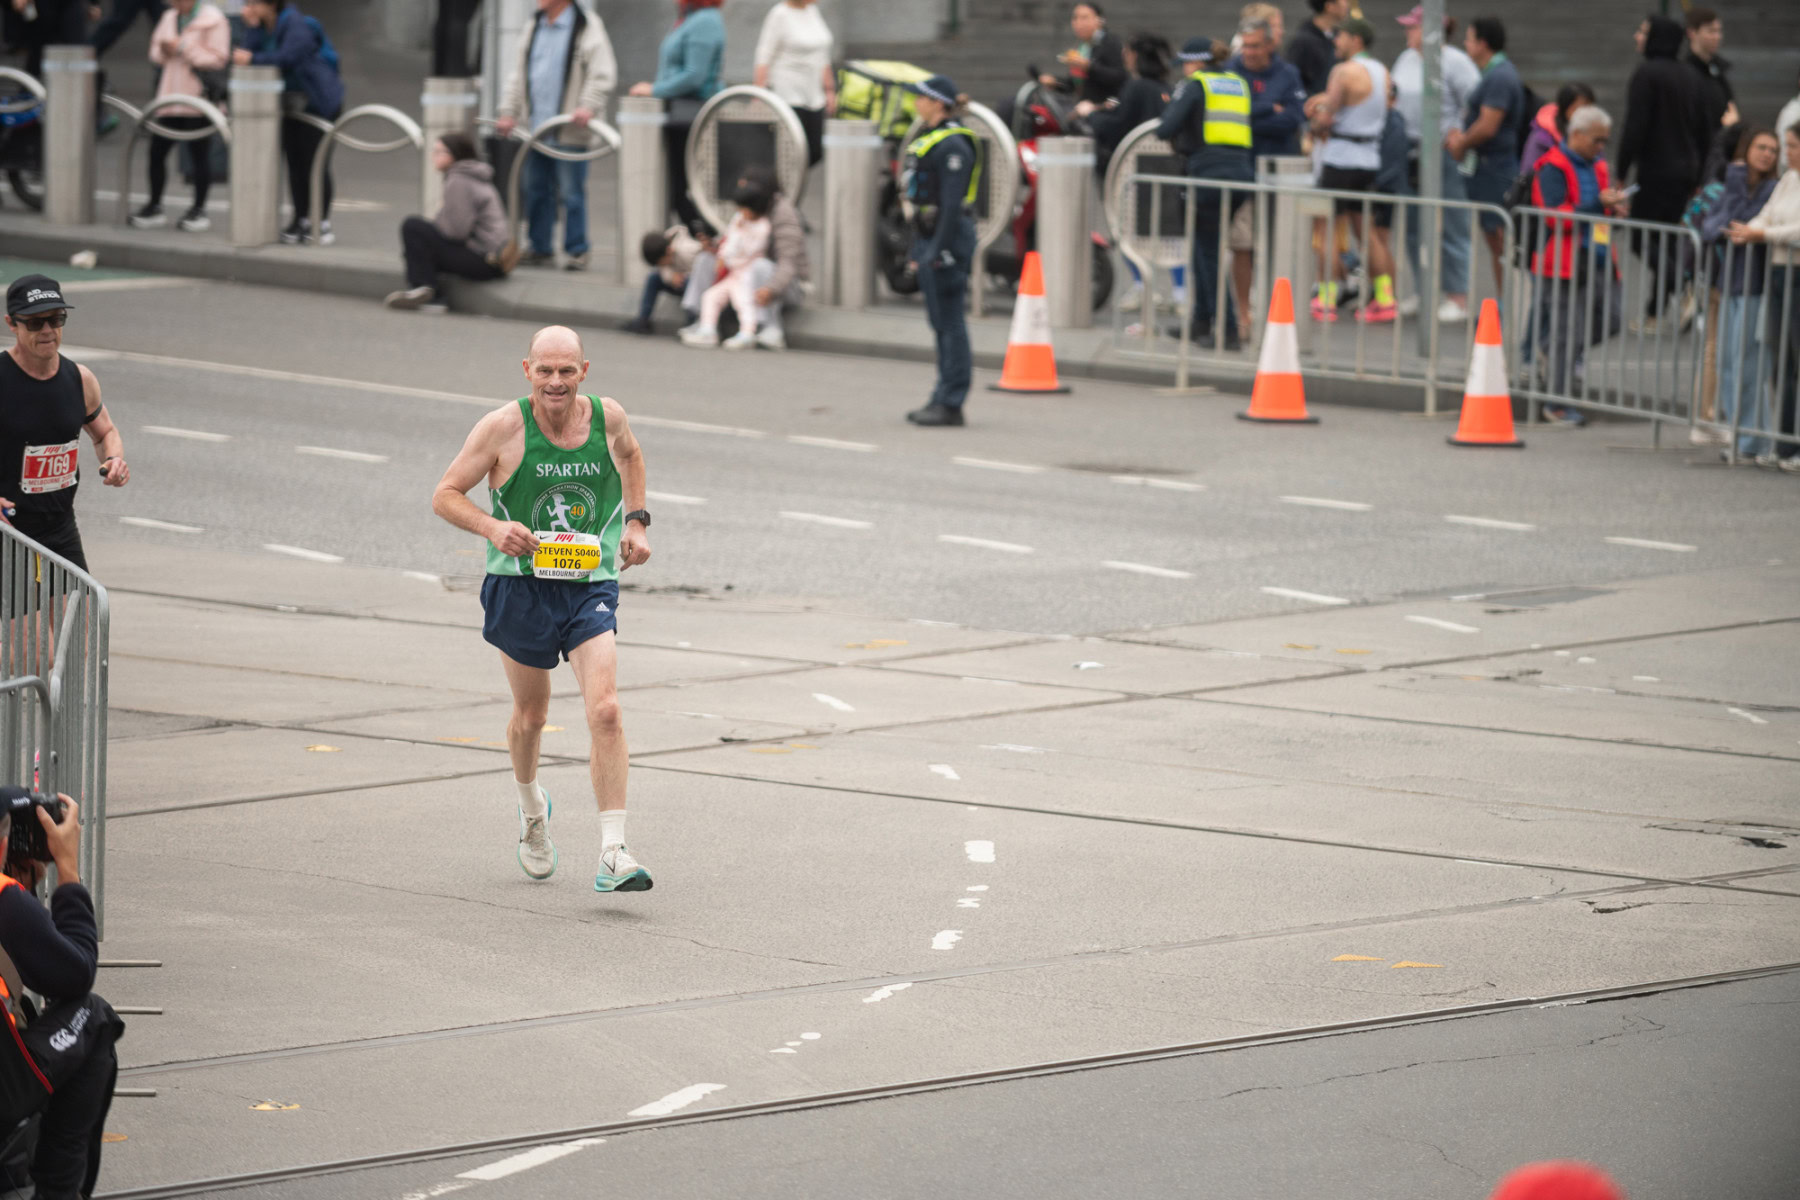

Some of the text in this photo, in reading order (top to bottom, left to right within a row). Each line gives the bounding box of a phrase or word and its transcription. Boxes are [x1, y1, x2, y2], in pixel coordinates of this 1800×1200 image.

[27, 289, 42, 298] AID
[28, 292, 60, 302] STATION
[37, 453, 69, 477] 7169
[536, 462, 600, 477] SPARTAN
[570, 505, 584, 516] 40
[537, 546, 572, 556] STEVEN
[553, 558, 581, 569] 1076
[539, 569, 576, 578] MELBOURNE
